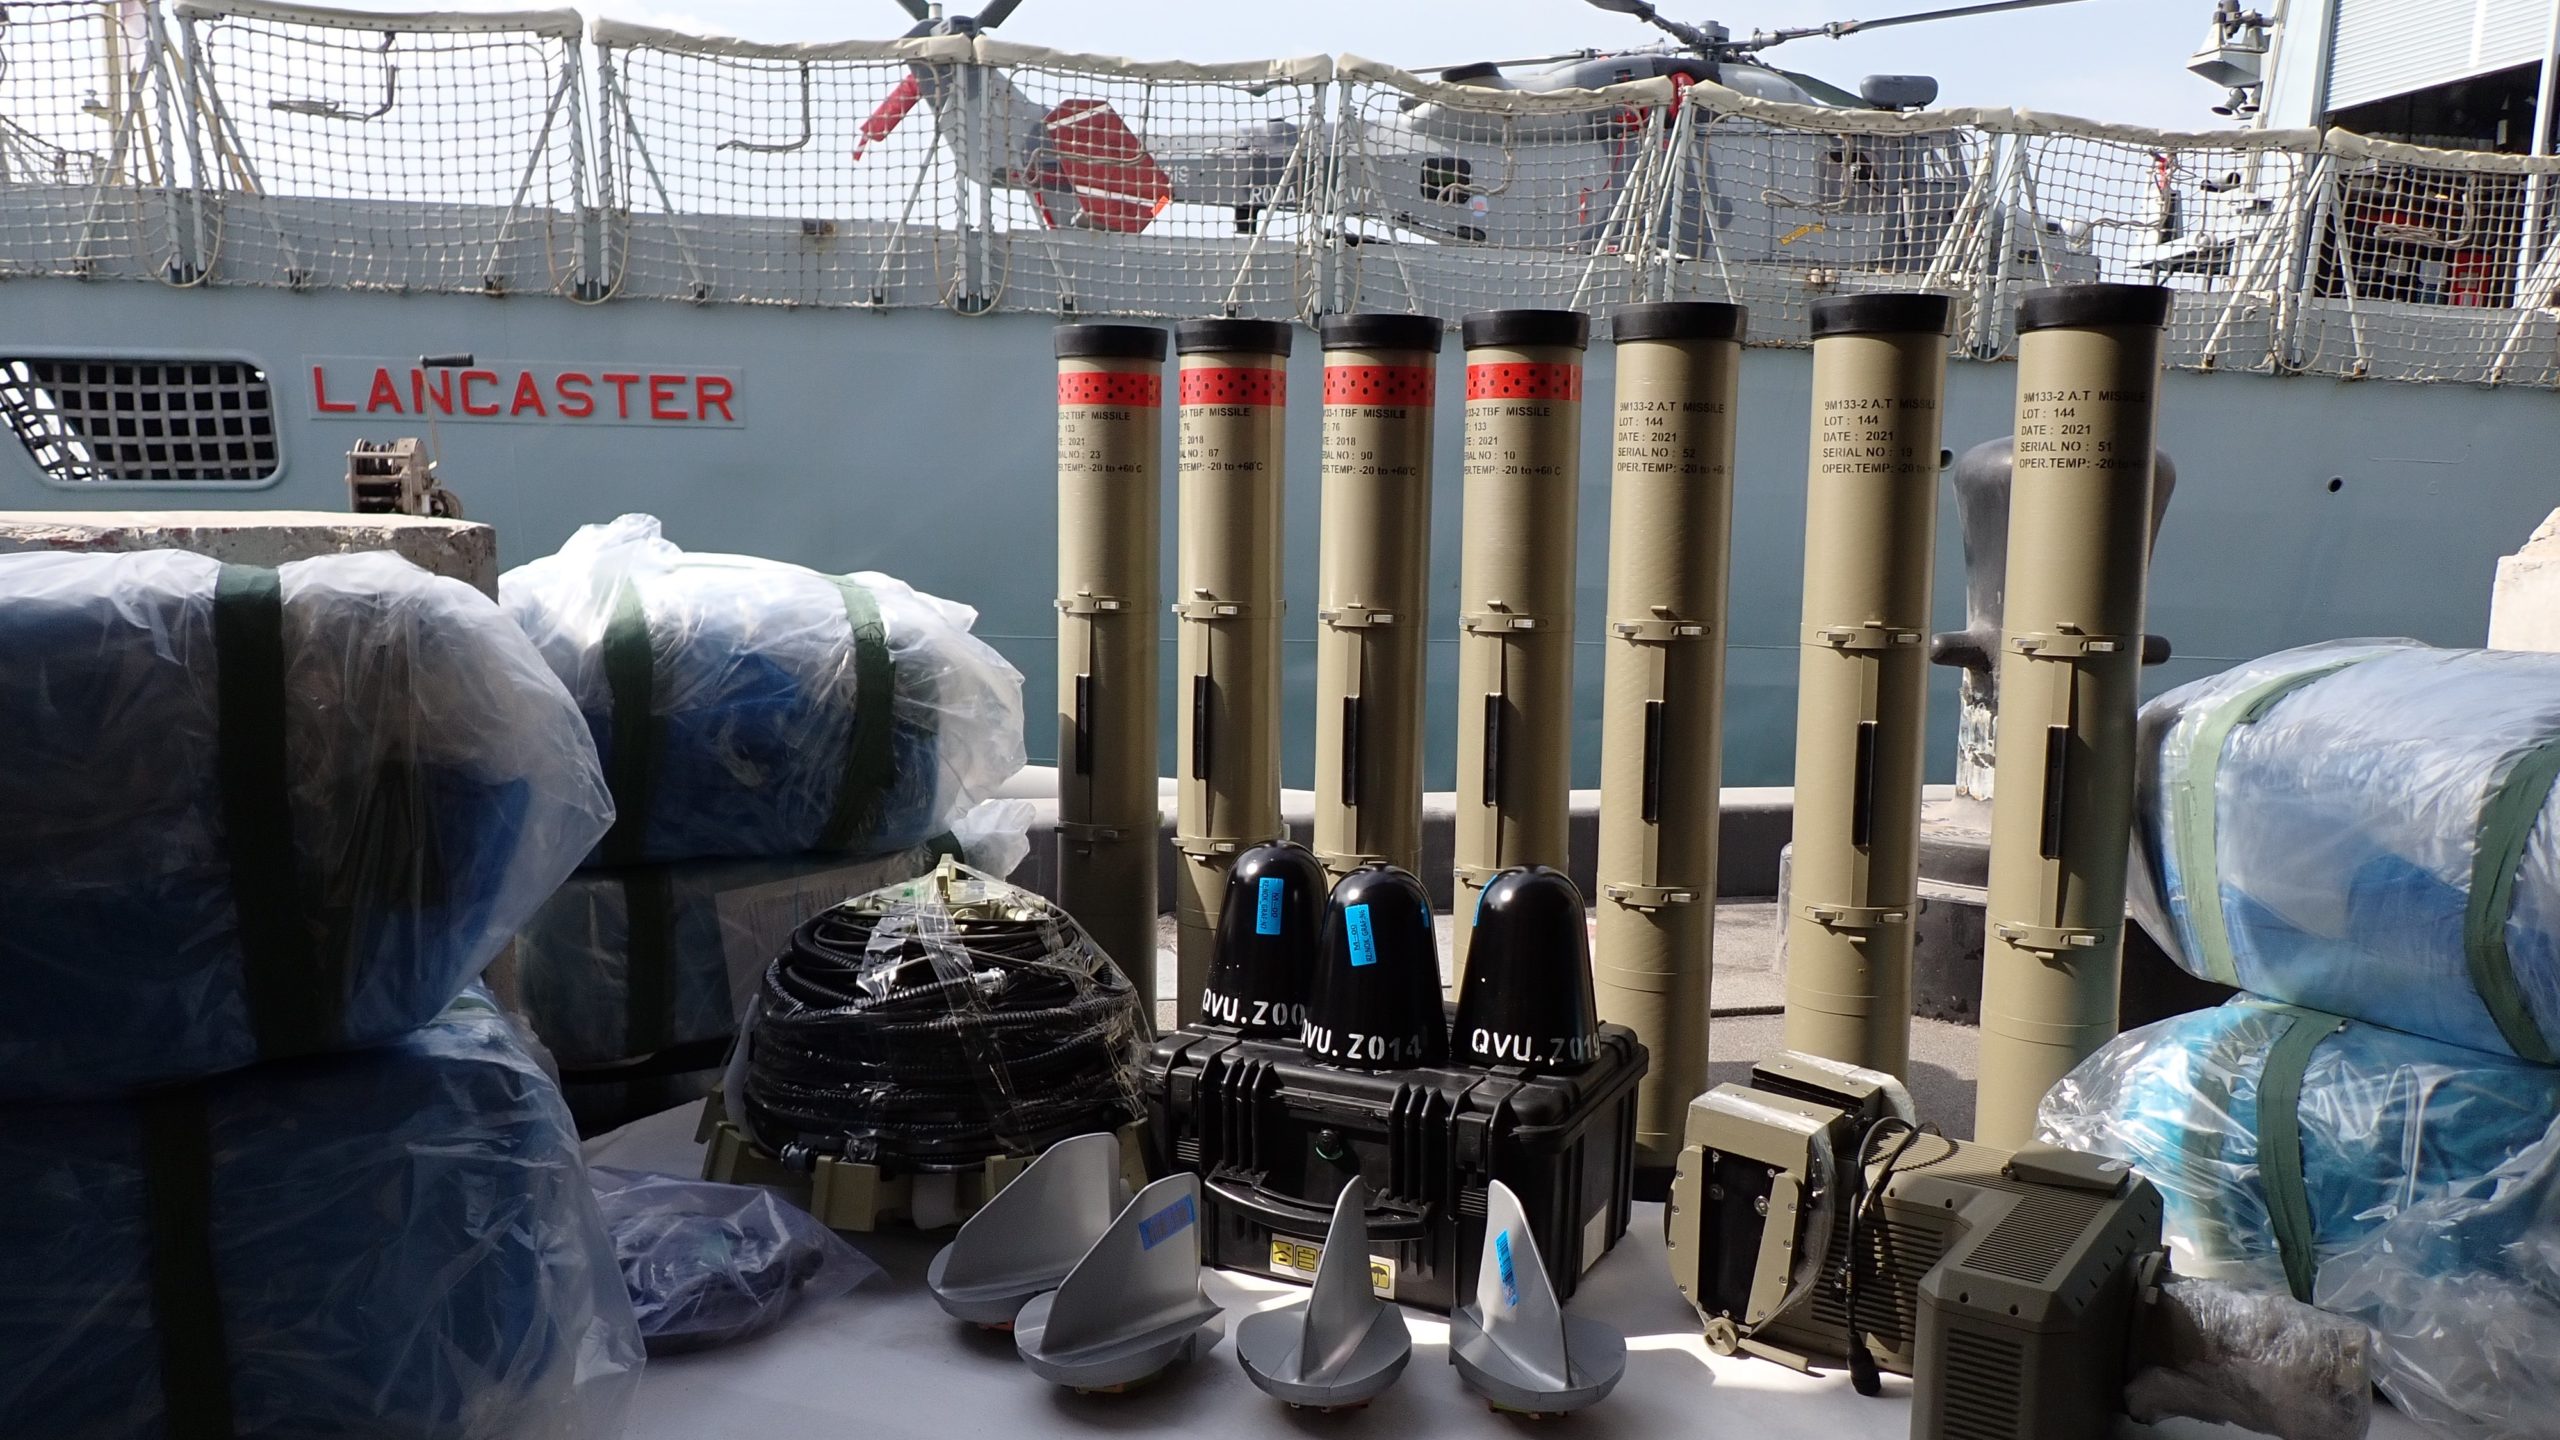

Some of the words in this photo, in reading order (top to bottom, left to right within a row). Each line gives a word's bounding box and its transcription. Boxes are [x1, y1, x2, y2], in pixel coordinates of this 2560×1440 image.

[1250, 185, 1299, 203] ROA
[313, 366, 734, 421] LANCASTER
[2023, 391, 2064, 403] 9M133-2
[2068, 390, 2091, 401] A.T
[1657, 401, 1676, 412] A.T
[1682, 402, 1725, 413] MISSILE
[1825, 399, 1868, 411] 9M133-2
[1871, 398, 1893, 409] A.T
[1091, 411, 1131, 420] MISSILE
[1209, 407, 1251, 417] MISSILE
[1340, 408, 1358, 417] TBF
[1363, 408, 1406, 419] MISSILE
[1482, 407, 1500, 416] TBF
[1506, 406, 1551, 417] MISSILE
[2022, 408, 2040, 419] LOT
[2054, 408, 2075, 418] 144
[1645, 417, 1663, 426] 144
[1824, 416, 1843, 426] LOT
[1858, 415, 1878, 425] 144
[1474, 422, 1487, 431] 133
[2021, 425, 2047, 436] DATE
[2061, 425, 2091, 435] 2021
[1068, 437, 1085, 446] 2021
[1187, 436, 1204, 445] 2018
[1336, 436, 1356, 446] 2018
[1478, 436, 1498, 446] 2021
[1618, 432, 1639, 441] DATE
[1651, 432, 1677, 442] 2021
[1823, 431, 1851, 442] DATE
[1865, 431, 1893, 441] 2021
[2020, 441, 2056, 452] SERIAL
[2061, 441, 2081, 451] NO
[2098, 441, 2112, 451] 51
[1090, 450, 1101, 459] 23
[1208, 448, 1219, 457] 87
[1360, 450, 1373, 460] 90
[1504, 450, 1516, 460] 10
[1617, 447, 1648, 457] SERIAL
[1682, 449, 1696, 458] 52
[1823, 447, 1861, 458] SERIAL
[1866, 447, 1885, 457] NO
[1207, 462, 1222, 471] -20
[1224, 462, 1234, 471] to
[2095, 458, 2113, 469] -20
[1359, 465, 1375, 475] -20
[1502, 465, 1518, 475] -20
[1521, 465, 1532, 475] to
[1202, 988, 1306, 1026] QVU.Z00
